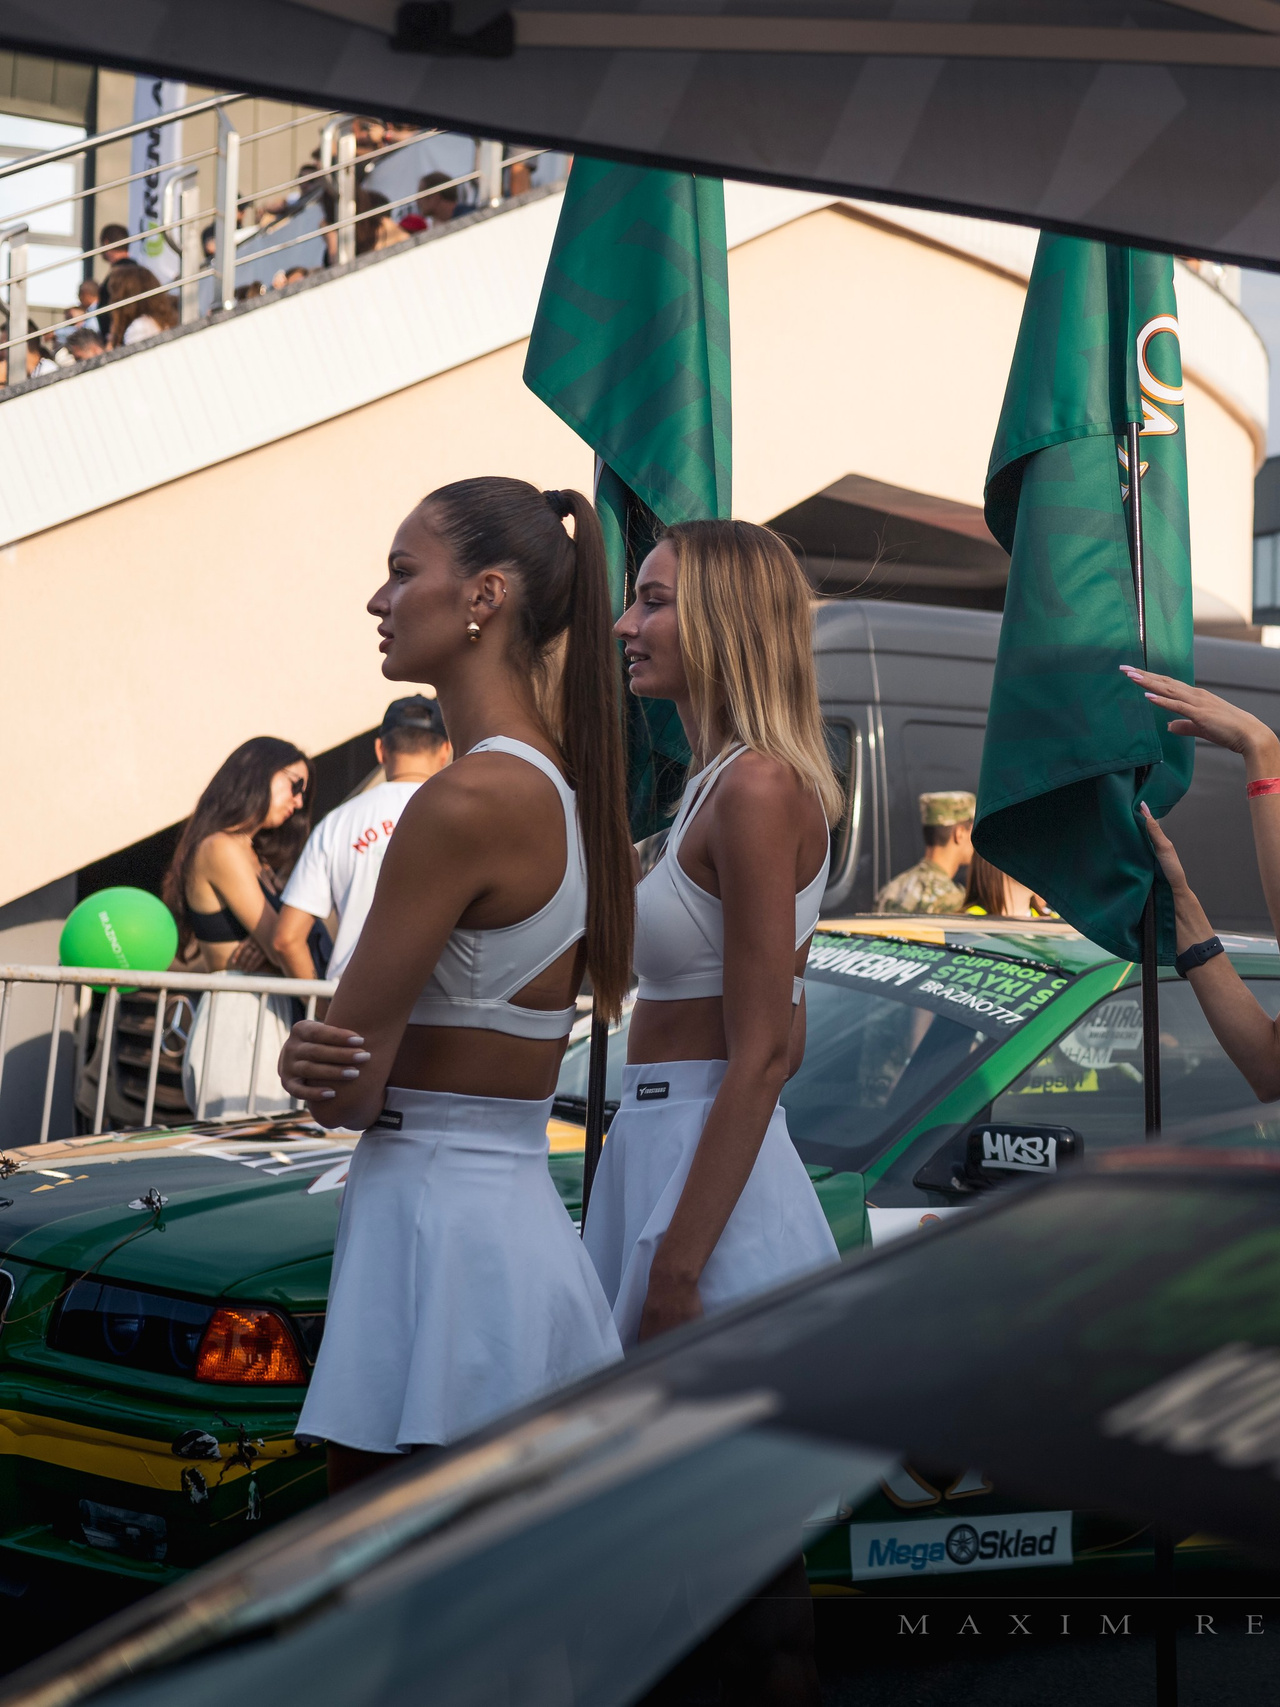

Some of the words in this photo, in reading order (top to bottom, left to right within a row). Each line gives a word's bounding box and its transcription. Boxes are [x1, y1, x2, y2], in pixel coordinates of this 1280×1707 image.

[353, 828, 378, 854] NO
[931, 965, 1033, 998] STAYKI
[951, 955, 995, 969] CUP
[990, 962, 1047, 983] PRO2
